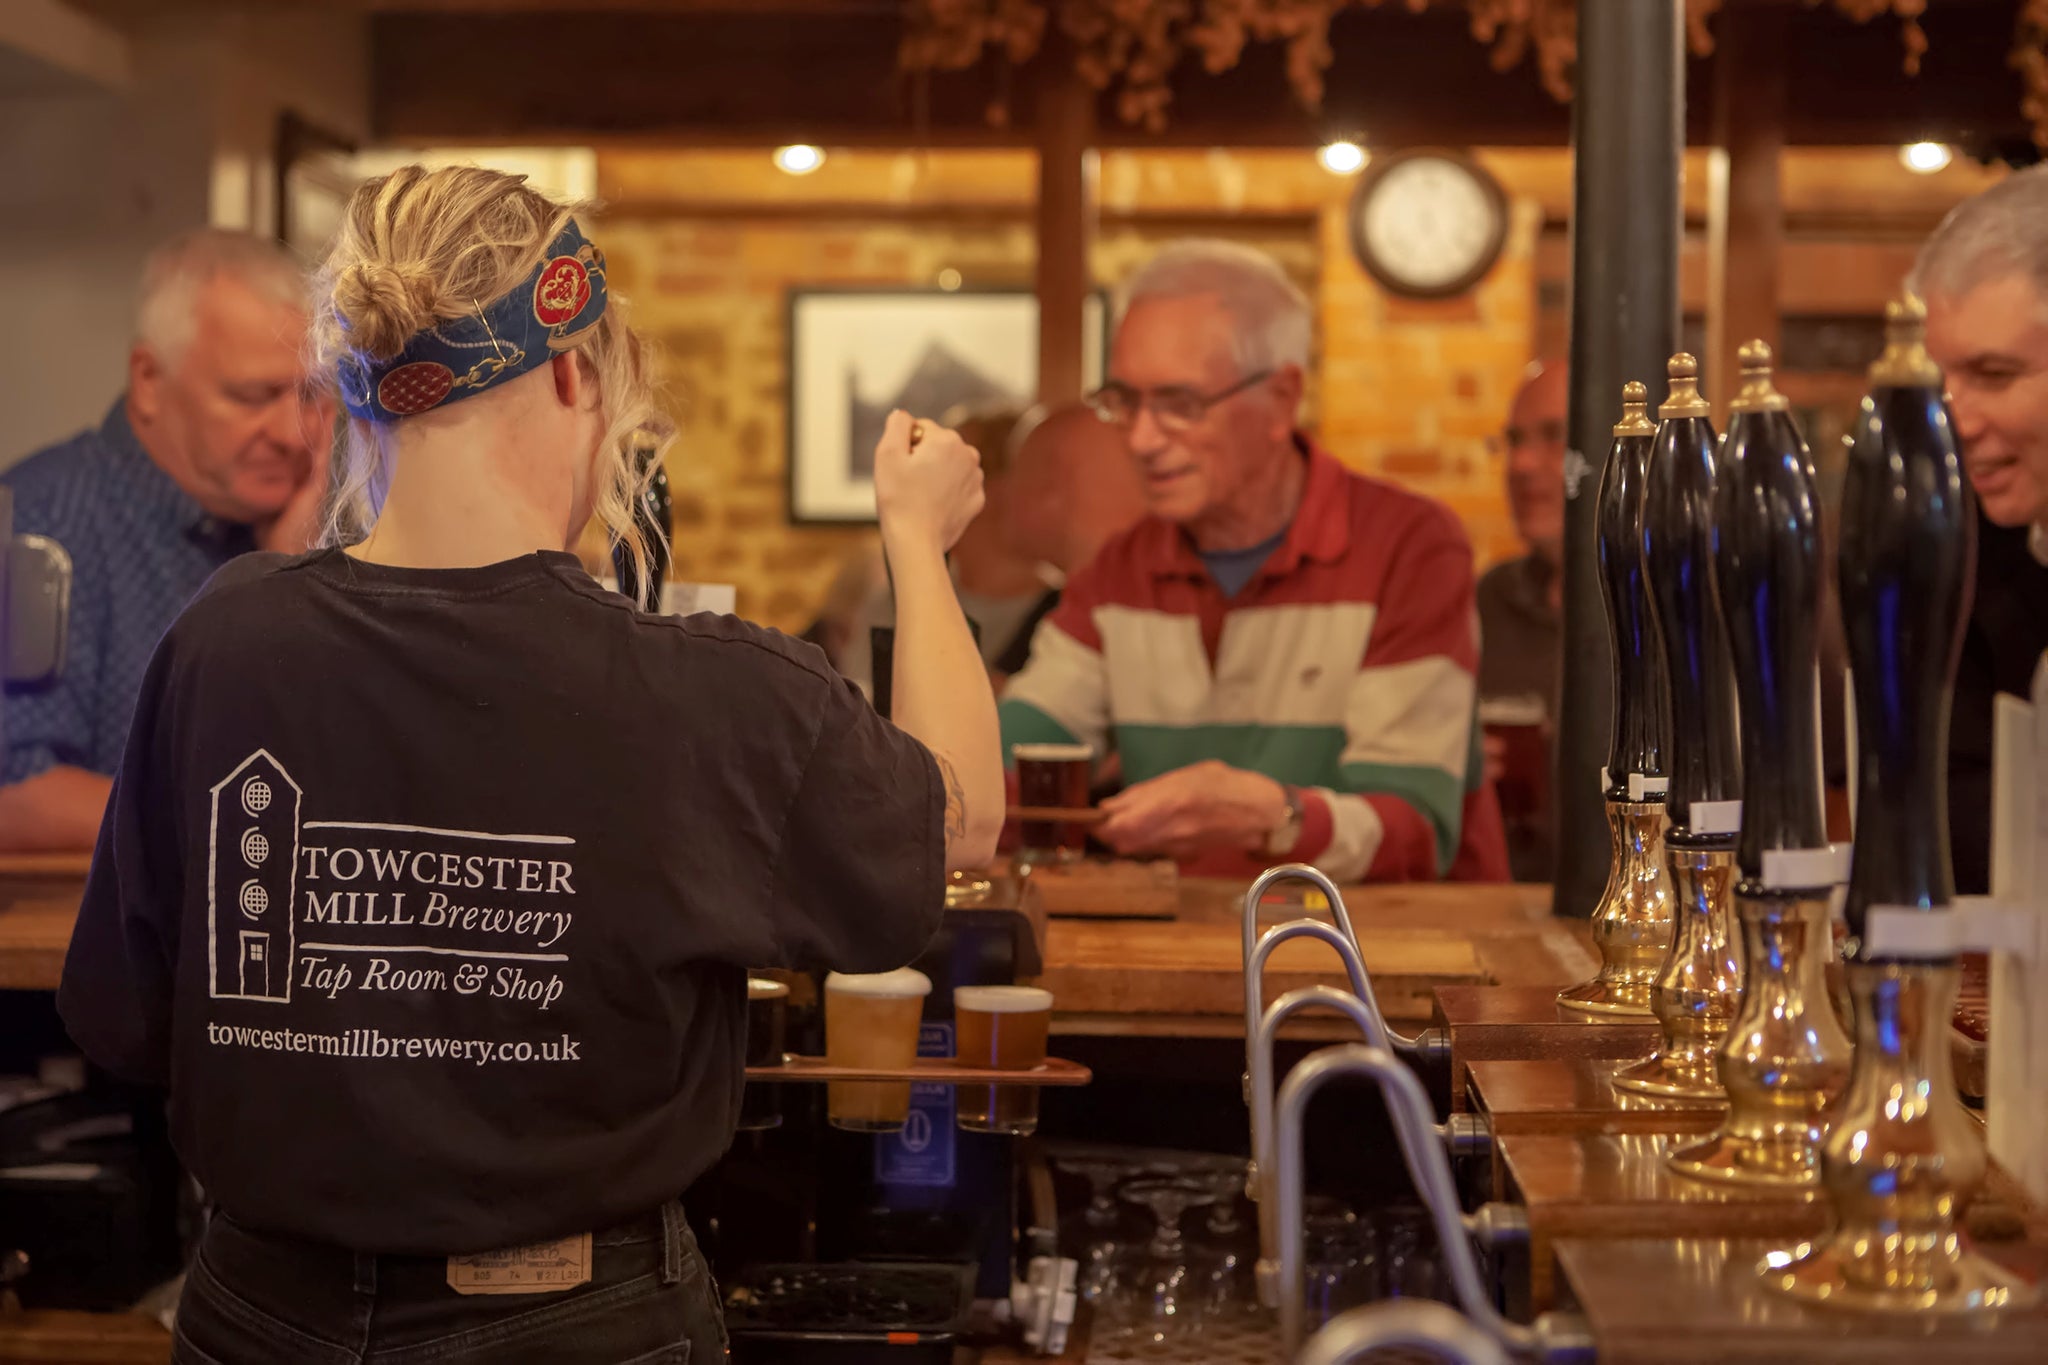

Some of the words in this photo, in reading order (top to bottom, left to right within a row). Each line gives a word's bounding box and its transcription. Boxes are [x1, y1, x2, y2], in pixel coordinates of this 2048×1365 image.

[302, 846, 577, 895] TOWCESTER
[303, 891, 415, 925] MILL
[420, 891, 573, 948] Brewery
[300, 956, 353, 1000] Tap
[358, 957, 448, 992] Room
[453, 963, 489, 995] &
[489, 966, 565, 1011] Shop
[206, 1021, 582, 1066] towcestermillbrewery.co.uk
